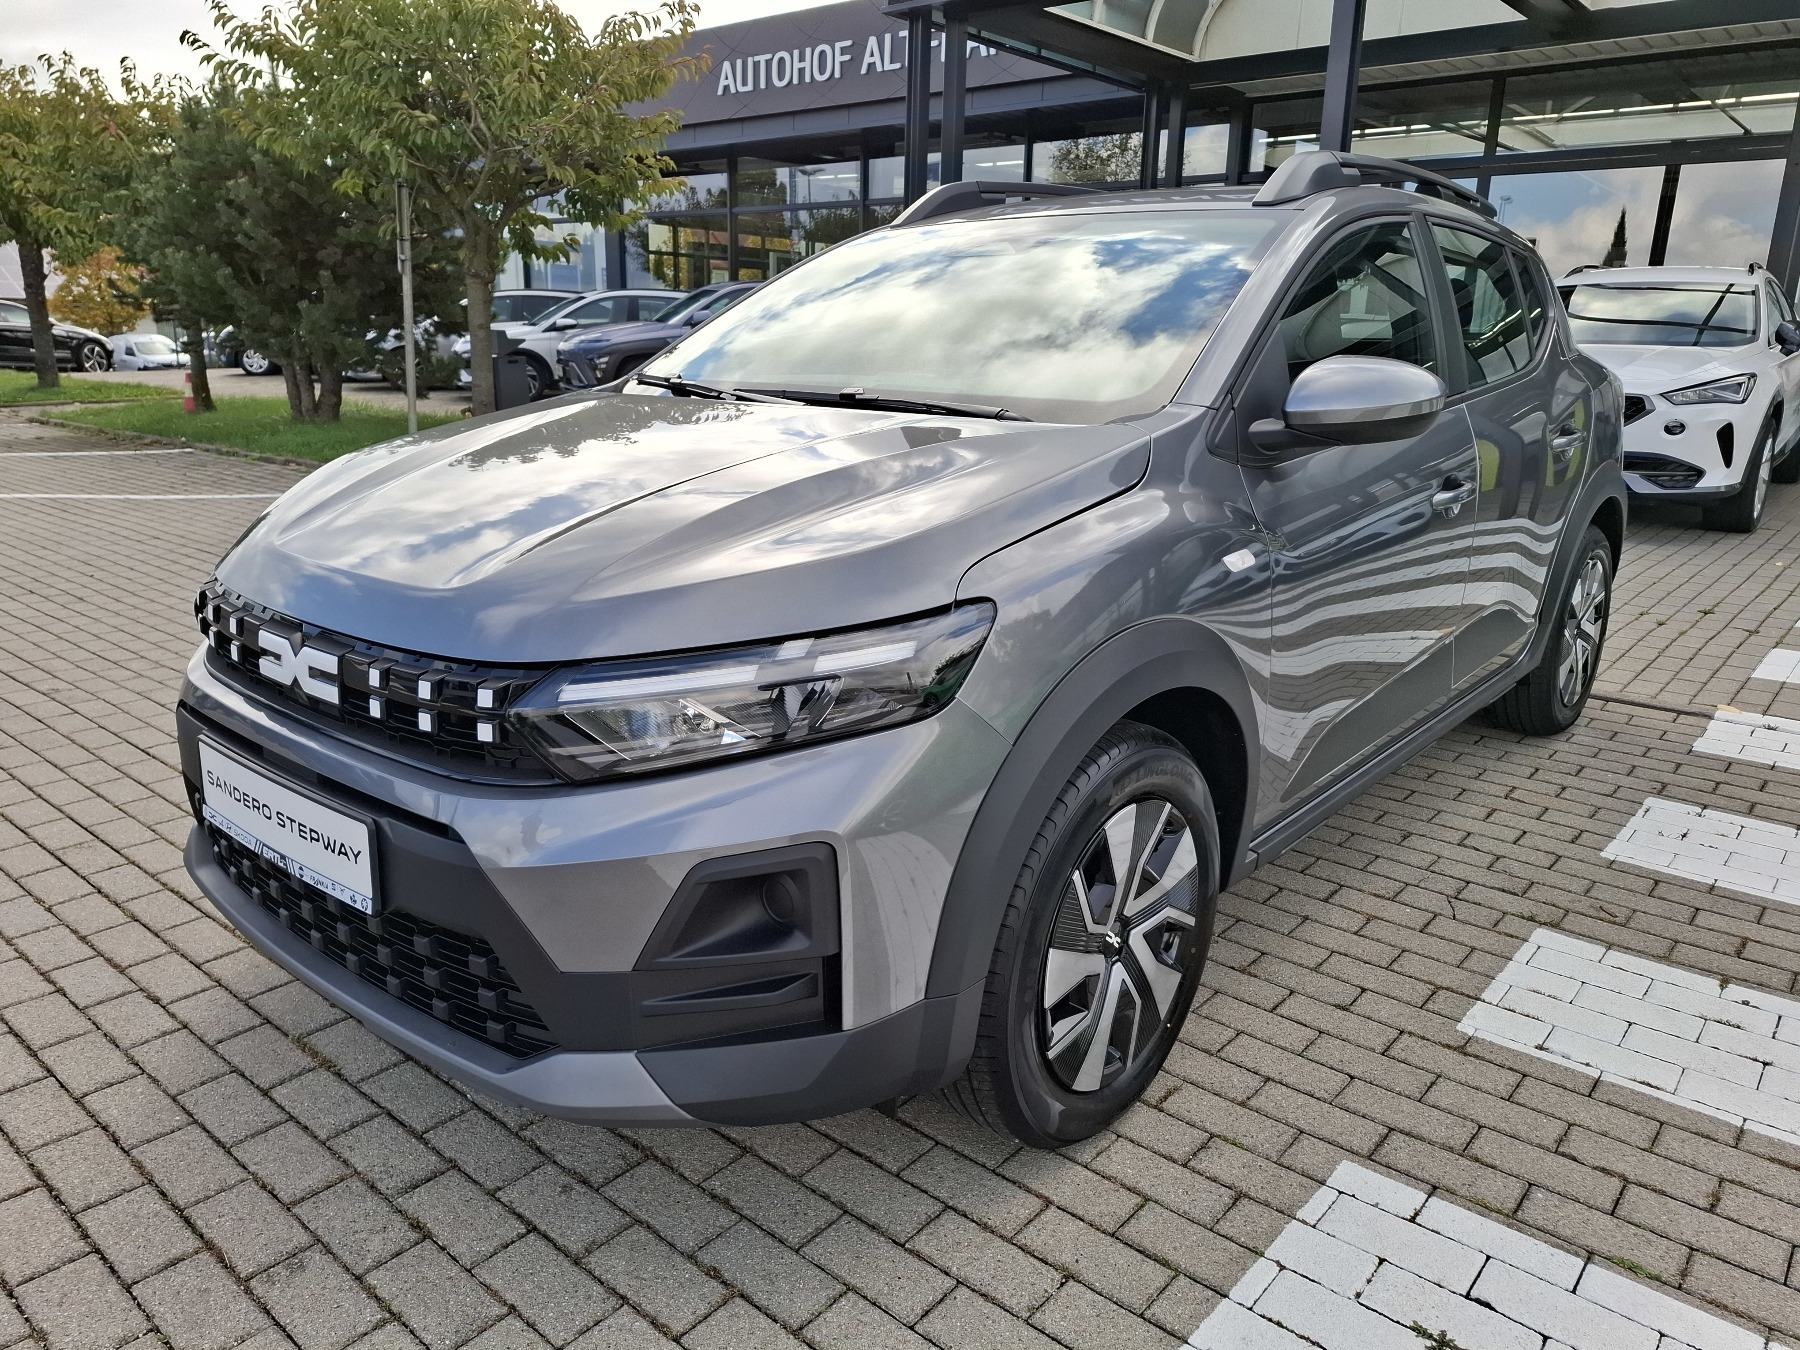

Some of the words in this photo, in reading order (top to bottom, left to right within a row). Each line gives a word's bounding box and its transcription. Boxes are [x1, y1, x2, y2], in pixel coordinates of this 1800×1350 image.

[716, 39, 854, 97] AUTOHOF
[206, 769, 272, 822] SANDERO
[276, 811, 362, 865] STEPWAY
